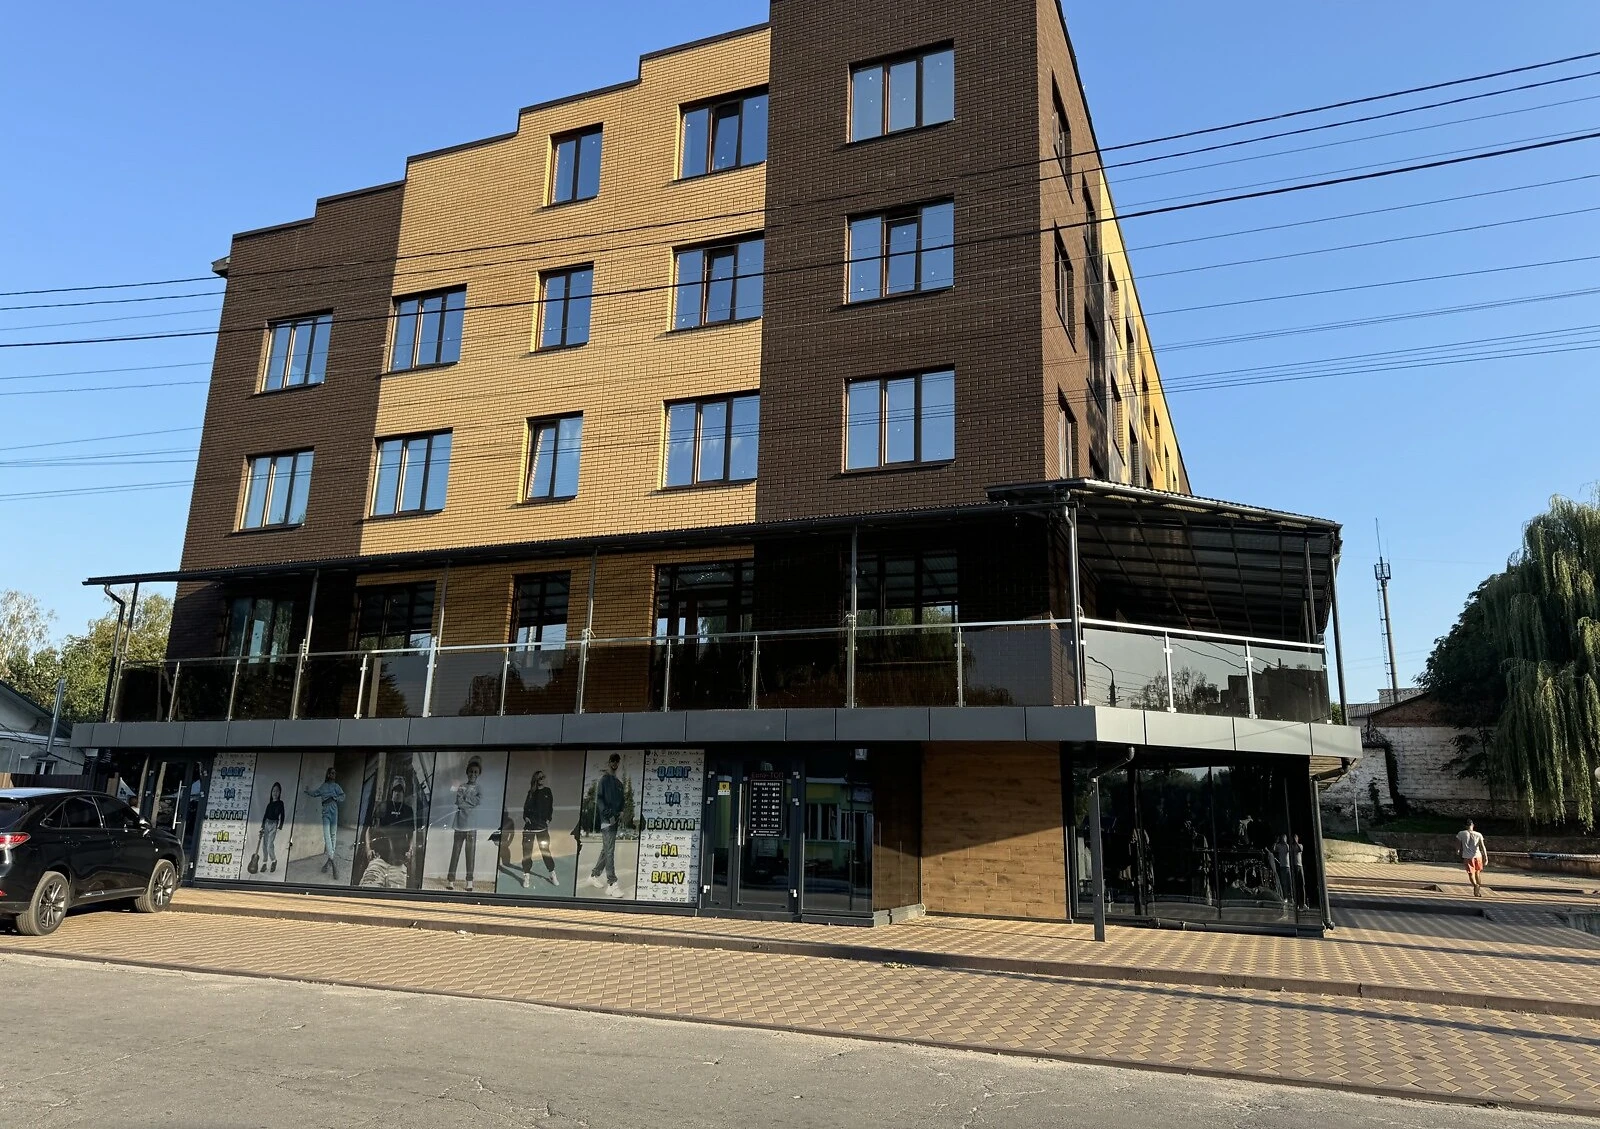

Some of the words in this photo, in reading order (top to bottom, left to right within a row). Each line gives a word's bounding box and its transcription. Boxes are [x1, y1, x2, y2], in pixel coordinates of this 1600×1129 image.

[220, 766, 246, 777] ОДЯГ
[657, 766, 692, 778] ОДЯГ
[223, 788, 236, 799] ТА
[664, 791, 681, 804] ТА
[209, 809, 244, 820] ВЗУТТЯ
[647, 818, 696, 830] ВЗУТТЯ
[216, 831, 230, 842] НА
[660, 844, 678, 857] НА
[207, 852, 232, 864] ВАГУ
[651, 870, 686, 884] ВАГУ
